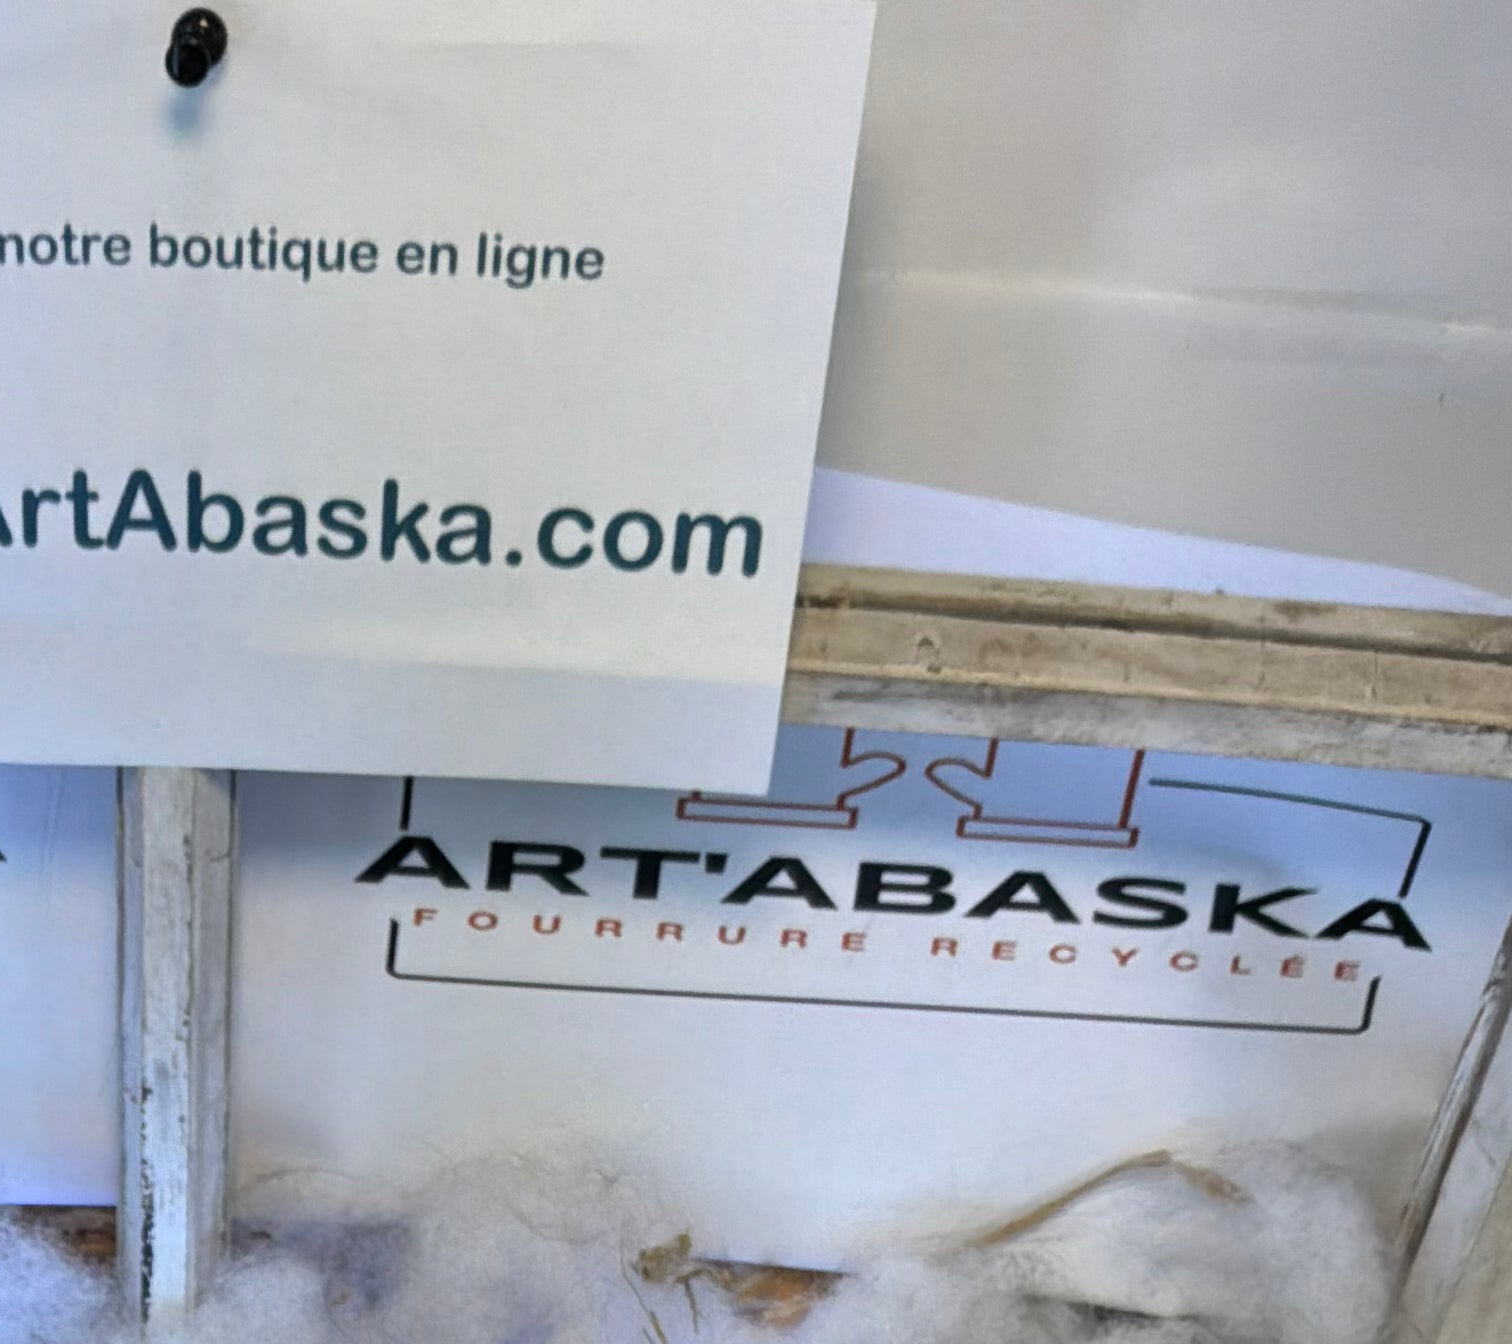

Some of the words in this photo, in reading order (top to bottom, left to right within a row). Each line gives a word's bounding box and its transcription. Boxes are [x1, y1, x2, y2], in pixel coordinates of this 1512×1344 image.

[149, 222, 379, 283] boutique
[394, 238, 460, 278] en
[475, 232, 605, 289] ligne
[354, 834, 1432, 952] ART'ABASKA
[415, 908, 866, 953] FOURRURE
[931, 937, 1361, 981] RECYCLÉE
